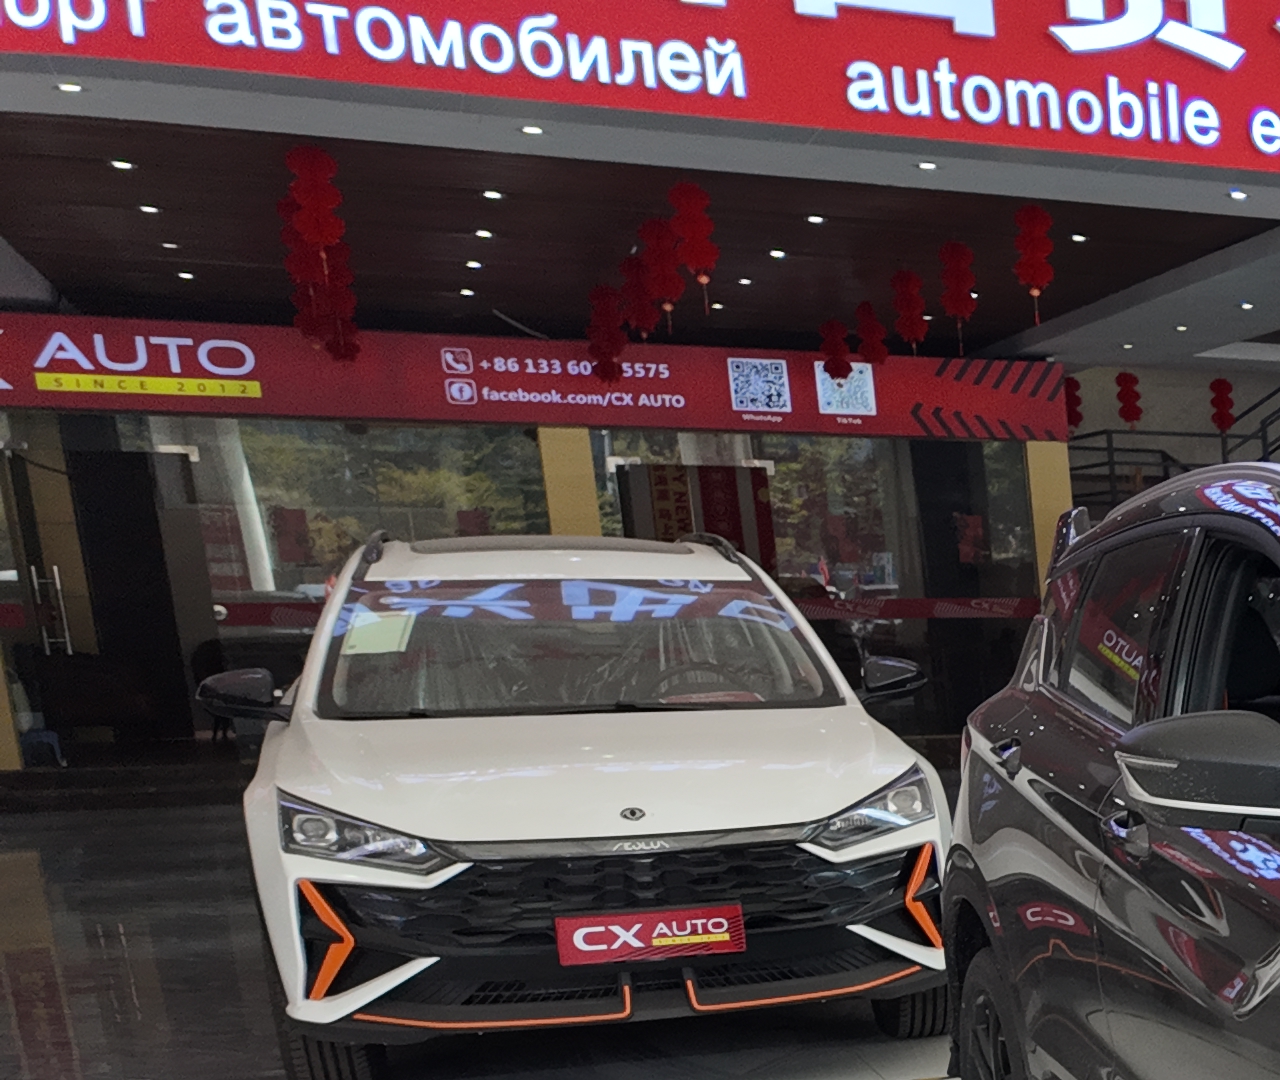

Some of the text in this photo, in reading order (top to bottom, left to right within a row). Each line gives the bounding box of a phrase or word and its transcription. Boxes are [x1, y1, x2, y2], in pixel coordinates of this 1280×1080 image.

[205, 0, 747, 97] автомобилей
[846, 57, 1221, 147] automobile
[33, 331, 256, 376] AUTO
[479, 357, 519, 373] +86
[525, 358, 562, 375] 133
[622, 363, 670, 379] 5575
[53, 377, 248, 394] SINCE 2012
[481, 386, 685, 408] facebook.com/CX AUTO
[572, 917, 729, 951] CX AUTO
